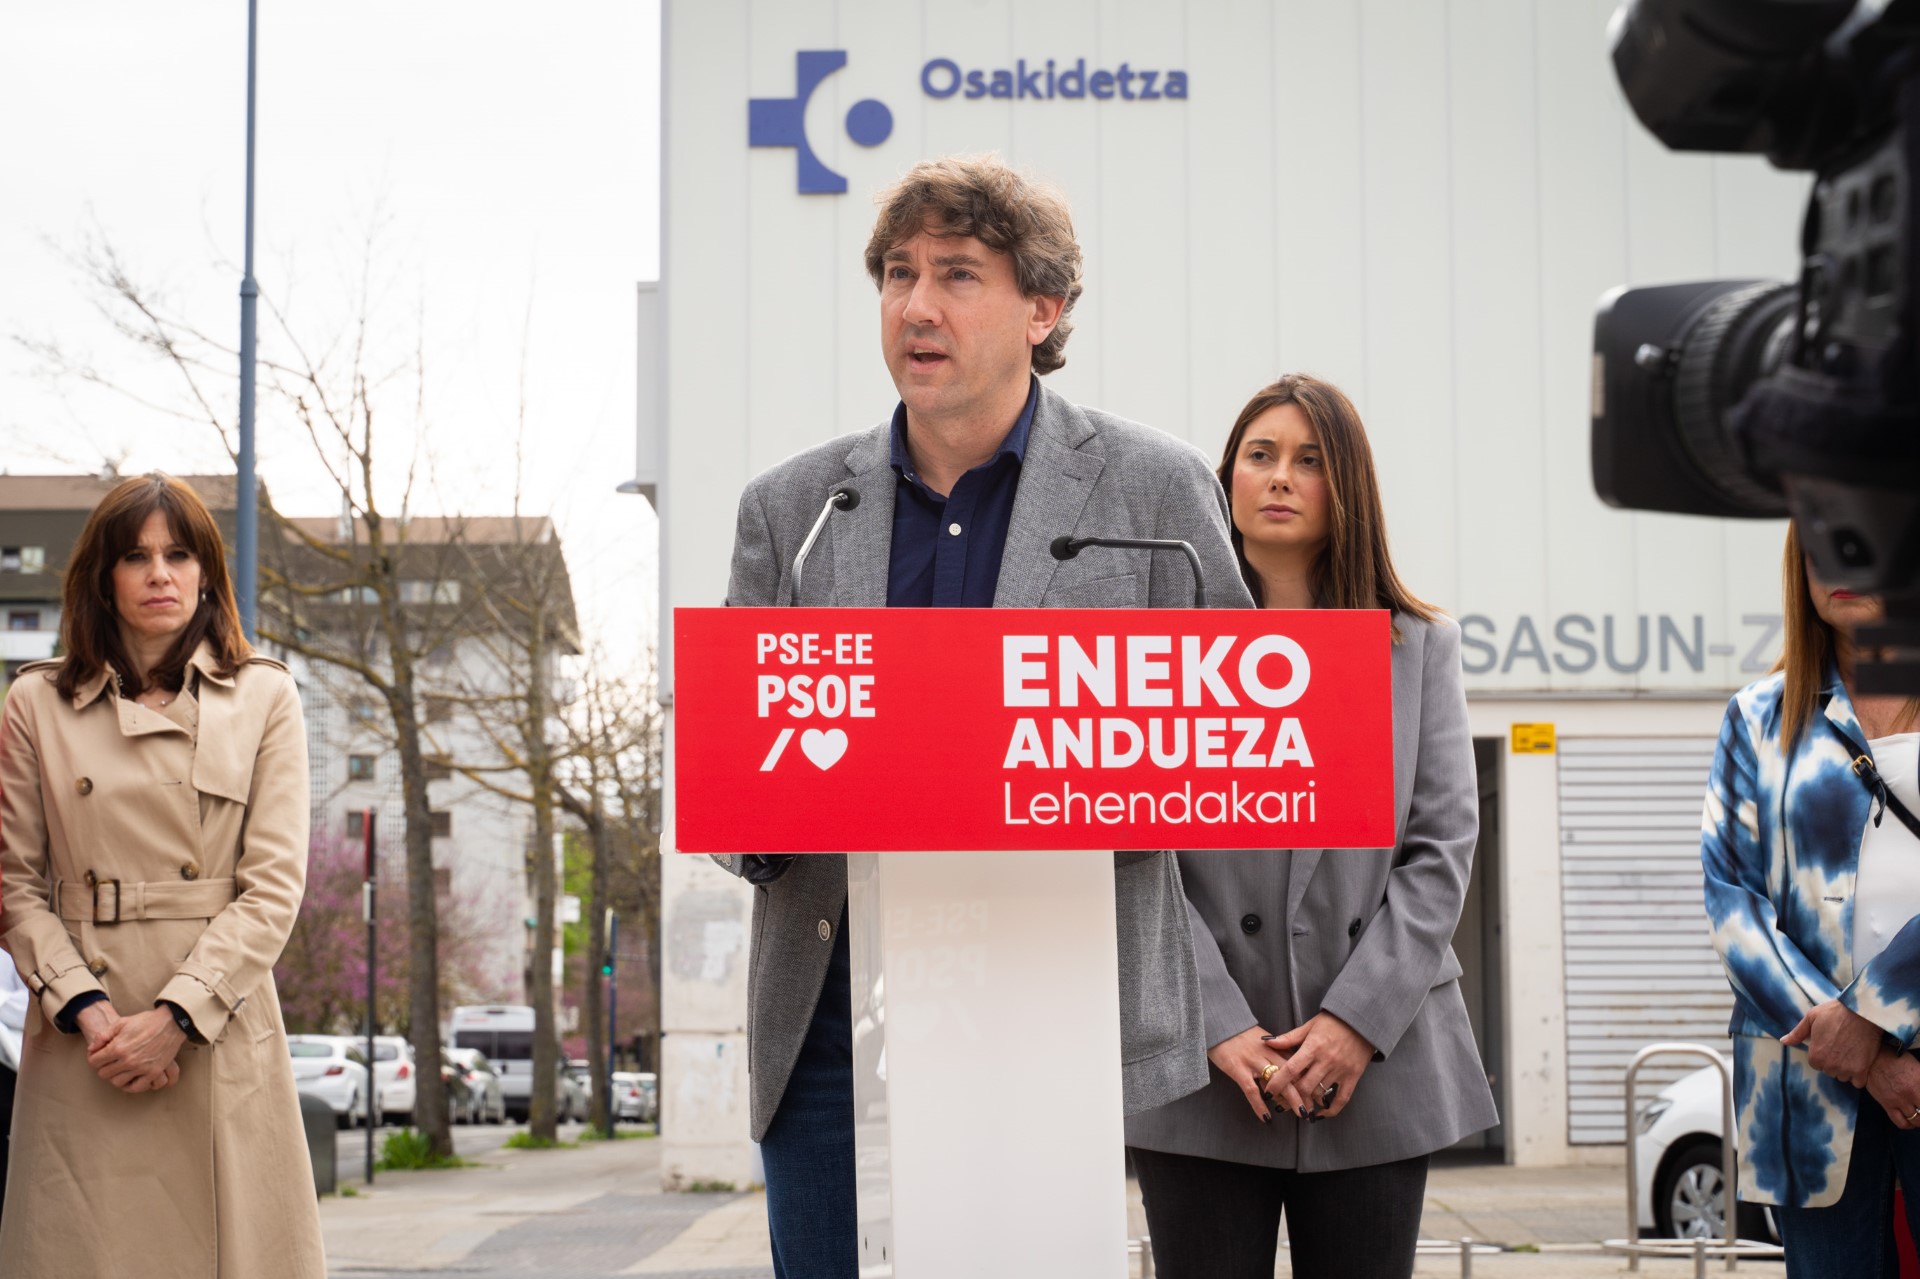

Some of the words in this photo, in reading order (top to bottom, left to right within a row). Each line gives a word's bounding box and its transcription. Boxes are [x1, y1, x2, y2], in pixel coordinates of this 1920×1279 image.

[920, 57, 1189, 100] Osakidetza
[757, 632, 874, 665] PSE-EE
[1003, 634, 1312, 709] ENEKO
[757, 674, 876, 719] PSOE
[1003, 717, 1315, 769] ANDUEZA
[1004, 780, 1317, 826] Lehendakari
